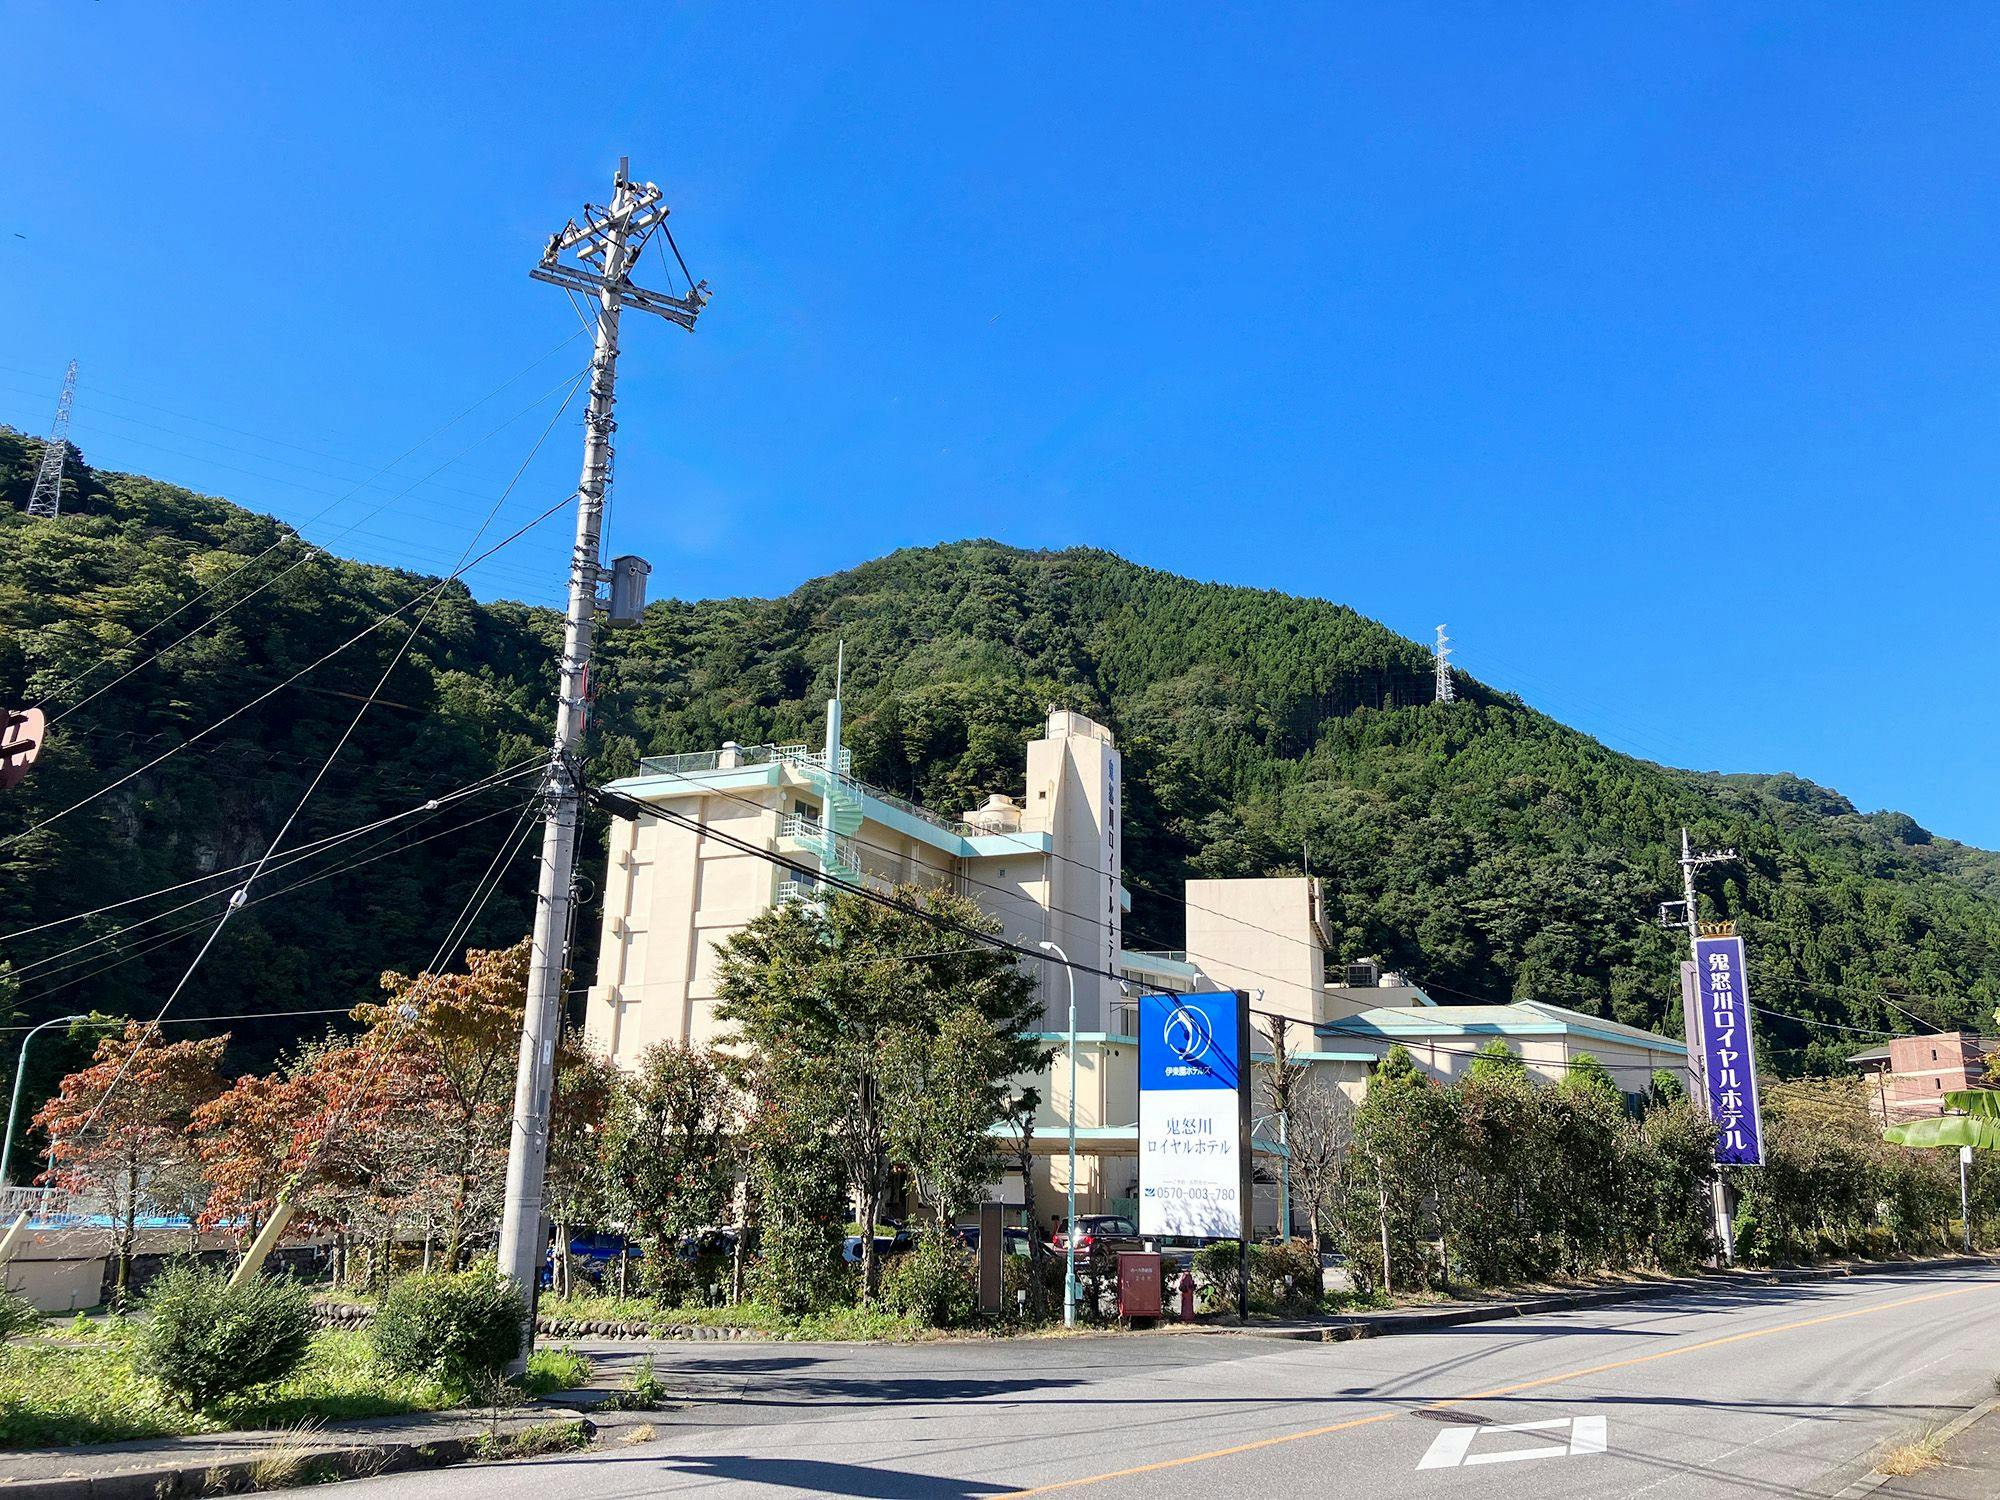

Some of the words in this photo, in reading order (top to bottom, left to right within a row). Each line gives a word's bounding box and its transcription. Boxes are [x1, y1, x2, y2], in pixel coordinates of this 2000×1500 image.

[1708, 953, 1747, 1150] 鬼怒川ロイヤルホテル
[1166, 1117, 1212, 1136] 鬼怒川
[1148, 1139, 1232, 1155] ロイヤルホテル
[1157, 1186, 1235, 1201] 0570-003-780
